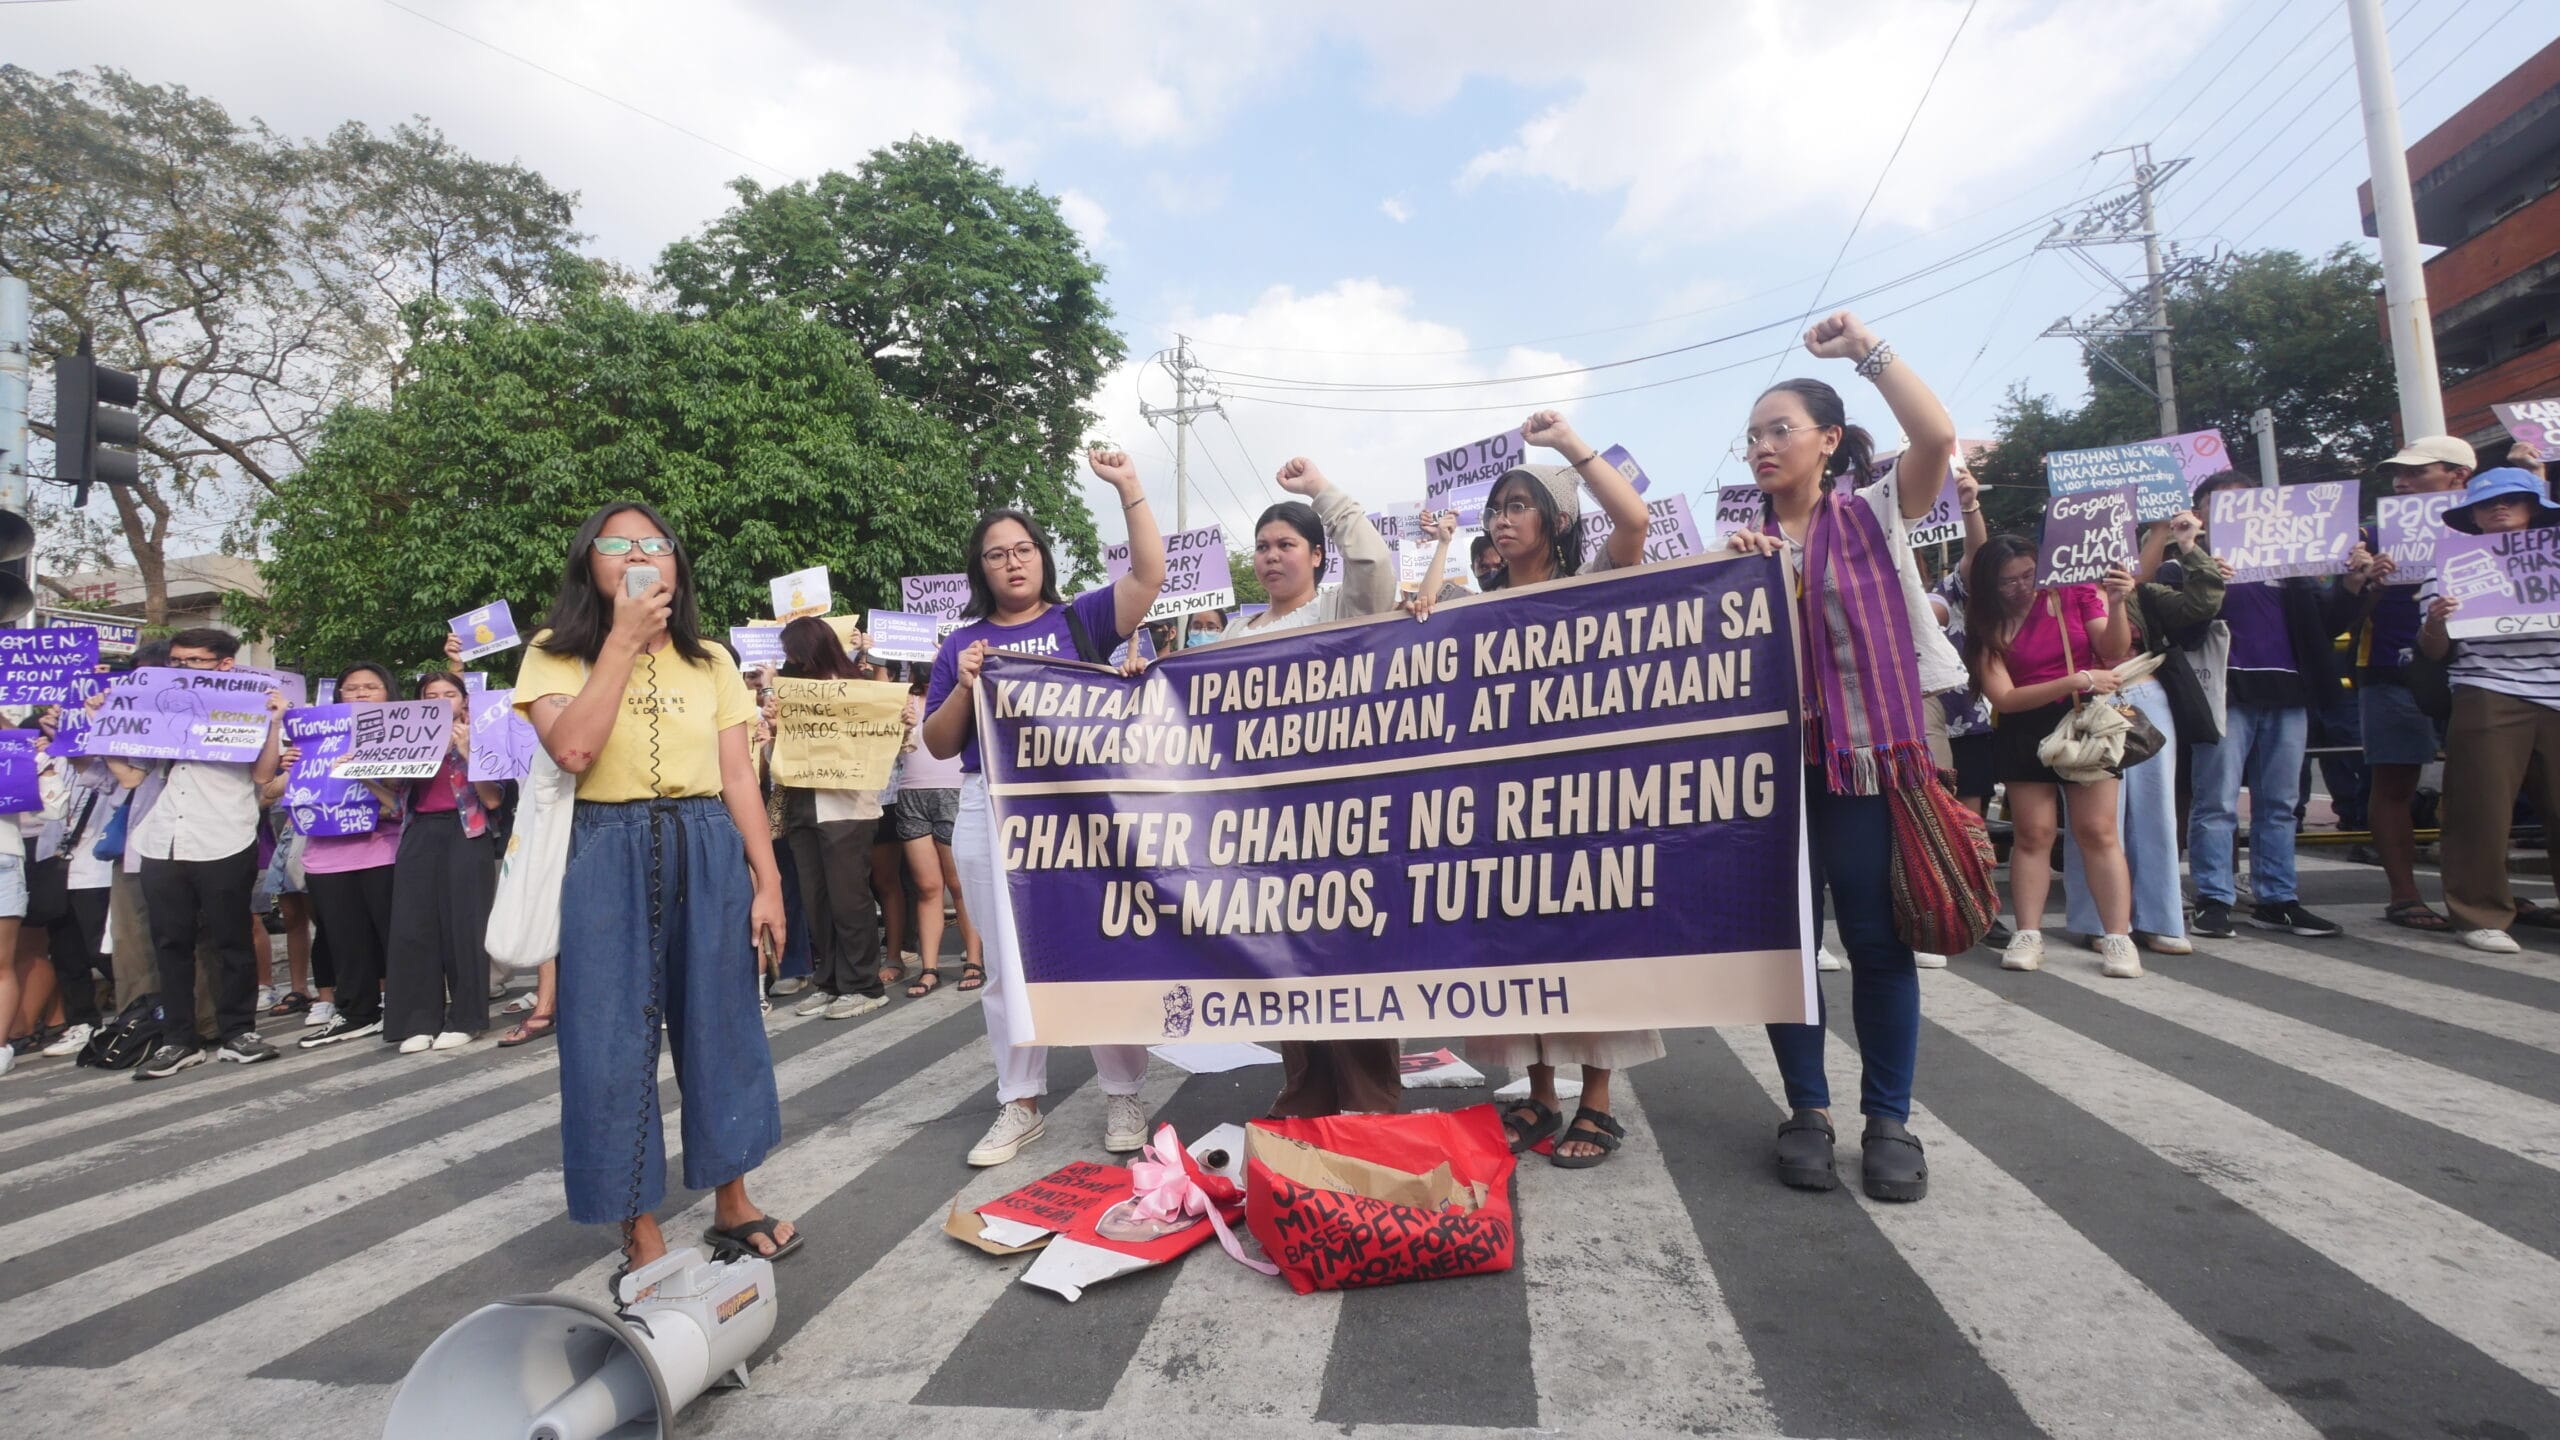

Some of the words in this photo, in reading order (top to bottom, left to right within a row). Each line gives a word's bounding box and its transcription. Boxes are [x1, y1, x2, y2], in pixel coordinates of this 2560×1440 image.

[1435, 447, 1468, 476] NO
[1475, 434, 1508, 464] TO
[2050, 449, 2118, 468] LISTAHAN
[2122, 446, 2141, 459] NG
[2143, 444, 2169, 457] MGA
[2052, 460, 2154, 481] NAKAKASUKA:
[1427, 477, 1454, 499] PUV
[2136, 504, 2181, 520] MISMO
[2244, 511, 2332, 548] RESIST
[2401, 526, 2436, 542] SA
[1166, 528, 1222, 553] EDCA
[1108, 546, 1129, 560] NO
[2214, 532, 2348, 570] UNITE!
[907, 596, 955, 615] MARSO
[1183, 592, 1225, 610] YOUTH
[995, 676, 1175, 723] KABATAAN,
[1188, 653, 1375, 716] IPAGLABAN
[1385, 637, 1459, 691] ANG
[1472, 597, 1704, 679] KARAPATAN
[1719, 587, 1773, 640] SA
[7, 669, 63, 682] FRONT
[777, 682, 848, 700] CHARTER
[110, 695, 138, 711] AY
[388, 706, 410, 720] NO
[421, 705, 440, 720] TO
[780, 703, 837, 719] CHANGE
[1016, 722, 1222, 771] EDUKASYON,
[1234, 692, 1456, 762] KABUHAYAN,
[1469, 683, 1516, 733] AT
[1529, 649, 1752, 735] KALAYAAN!
[388, 724, 442, 744] PUV
[842, 721, 901, 738] TUTULAN
[351, 745, 439, 762] PHASEOUT!
[344, 764, 396, 777] GABRIELA
[400, 763, 435, 775] YOUTH
[1000, 813, 1192, 872] CHARTER
[1208, 794, 1392, 867] CHANGE
[1409, 785, 1475, 850] NG
[1496, 752, 1775, 842] REHIMENG
[340, 816, 373, 833] SHS
[1101, 868, 1388, 937] US-MARCOS,
[1408, 843, 1656, 924] TUTULAN!
[1201, 986, 1405, 1028] GABRIELA
[1417, 976, 1570, 1020] YOUTH
[1284, 1212, 1353, 1265] BASES
